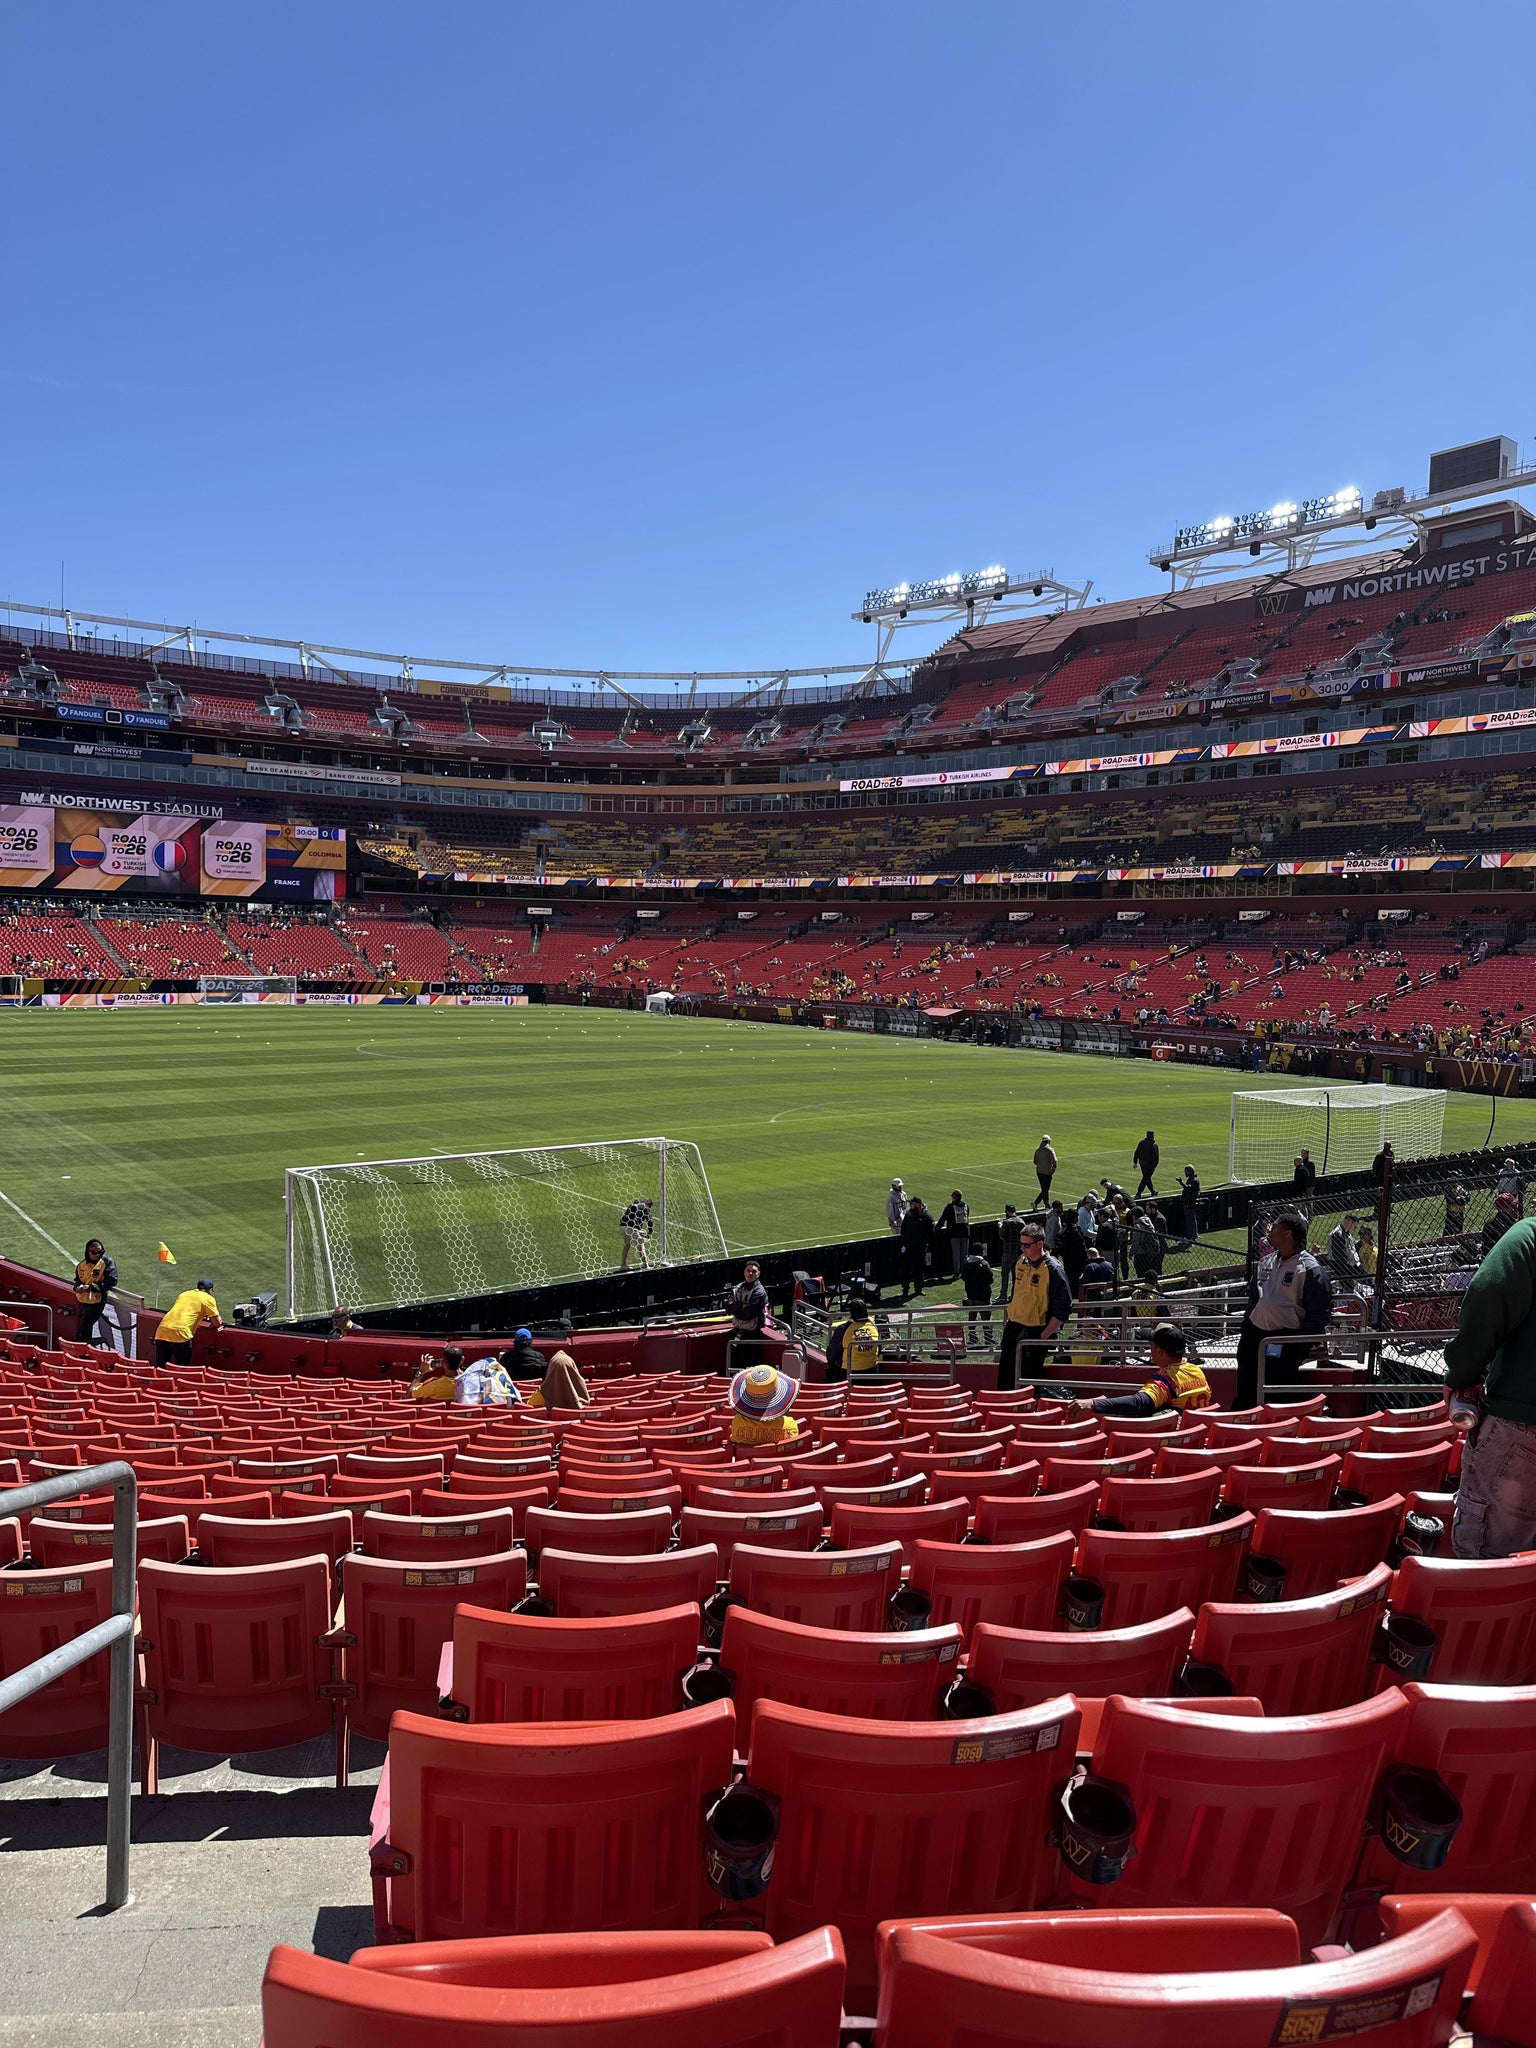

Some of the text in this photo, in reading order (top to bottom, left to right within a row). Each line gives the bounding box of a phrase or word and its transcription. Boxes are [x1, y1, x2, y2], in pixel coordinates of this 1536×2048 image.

[1343, 556, 1490, 600] NORTHWEST
[1426, 664, 1472, 675] NORTHWEST
[440, 685, 490, 698] COMMANDERS
[1318, 682, 1349, 695] 30:00
[1361, 678, 1369, 689] 0
[1226, 694, 1264, 704] NORTHWEST
[70, 709, 102, 718] FANDUEL
[1490, 712, 1520, 722] ROAD
[1528, 710, 1536, 718] 2
[136, 716, 168, 726] FANDUEL
[1280, 738, 1304, 746] ROAD
[94, 745, 142, 756] NORTHWEST
[279, 768, 308, 776] AMERICA
[851, 780, 881, 790] ROAD
[890, 777, 902, 788] 26
[50, 794, 150, 812] NORTHWEST
[152, 802, 223, 818] STADIUM
[112, 834, 146, 844] ROAD
[12, 838, 38, 851] 26
[112, 844, 146, 855] TO 26
[216, 840, 252, 850] ROAD
[228, 851, 252, 863] 26
[308, 850, 342, 858] COLOMBIA
[1346, 860, 1371, 868] ROAD
[508, 984, 524, 994] 26
[1156, 1048, 1164, 1058] G
[854, 1328, 872, 1337] CSC
